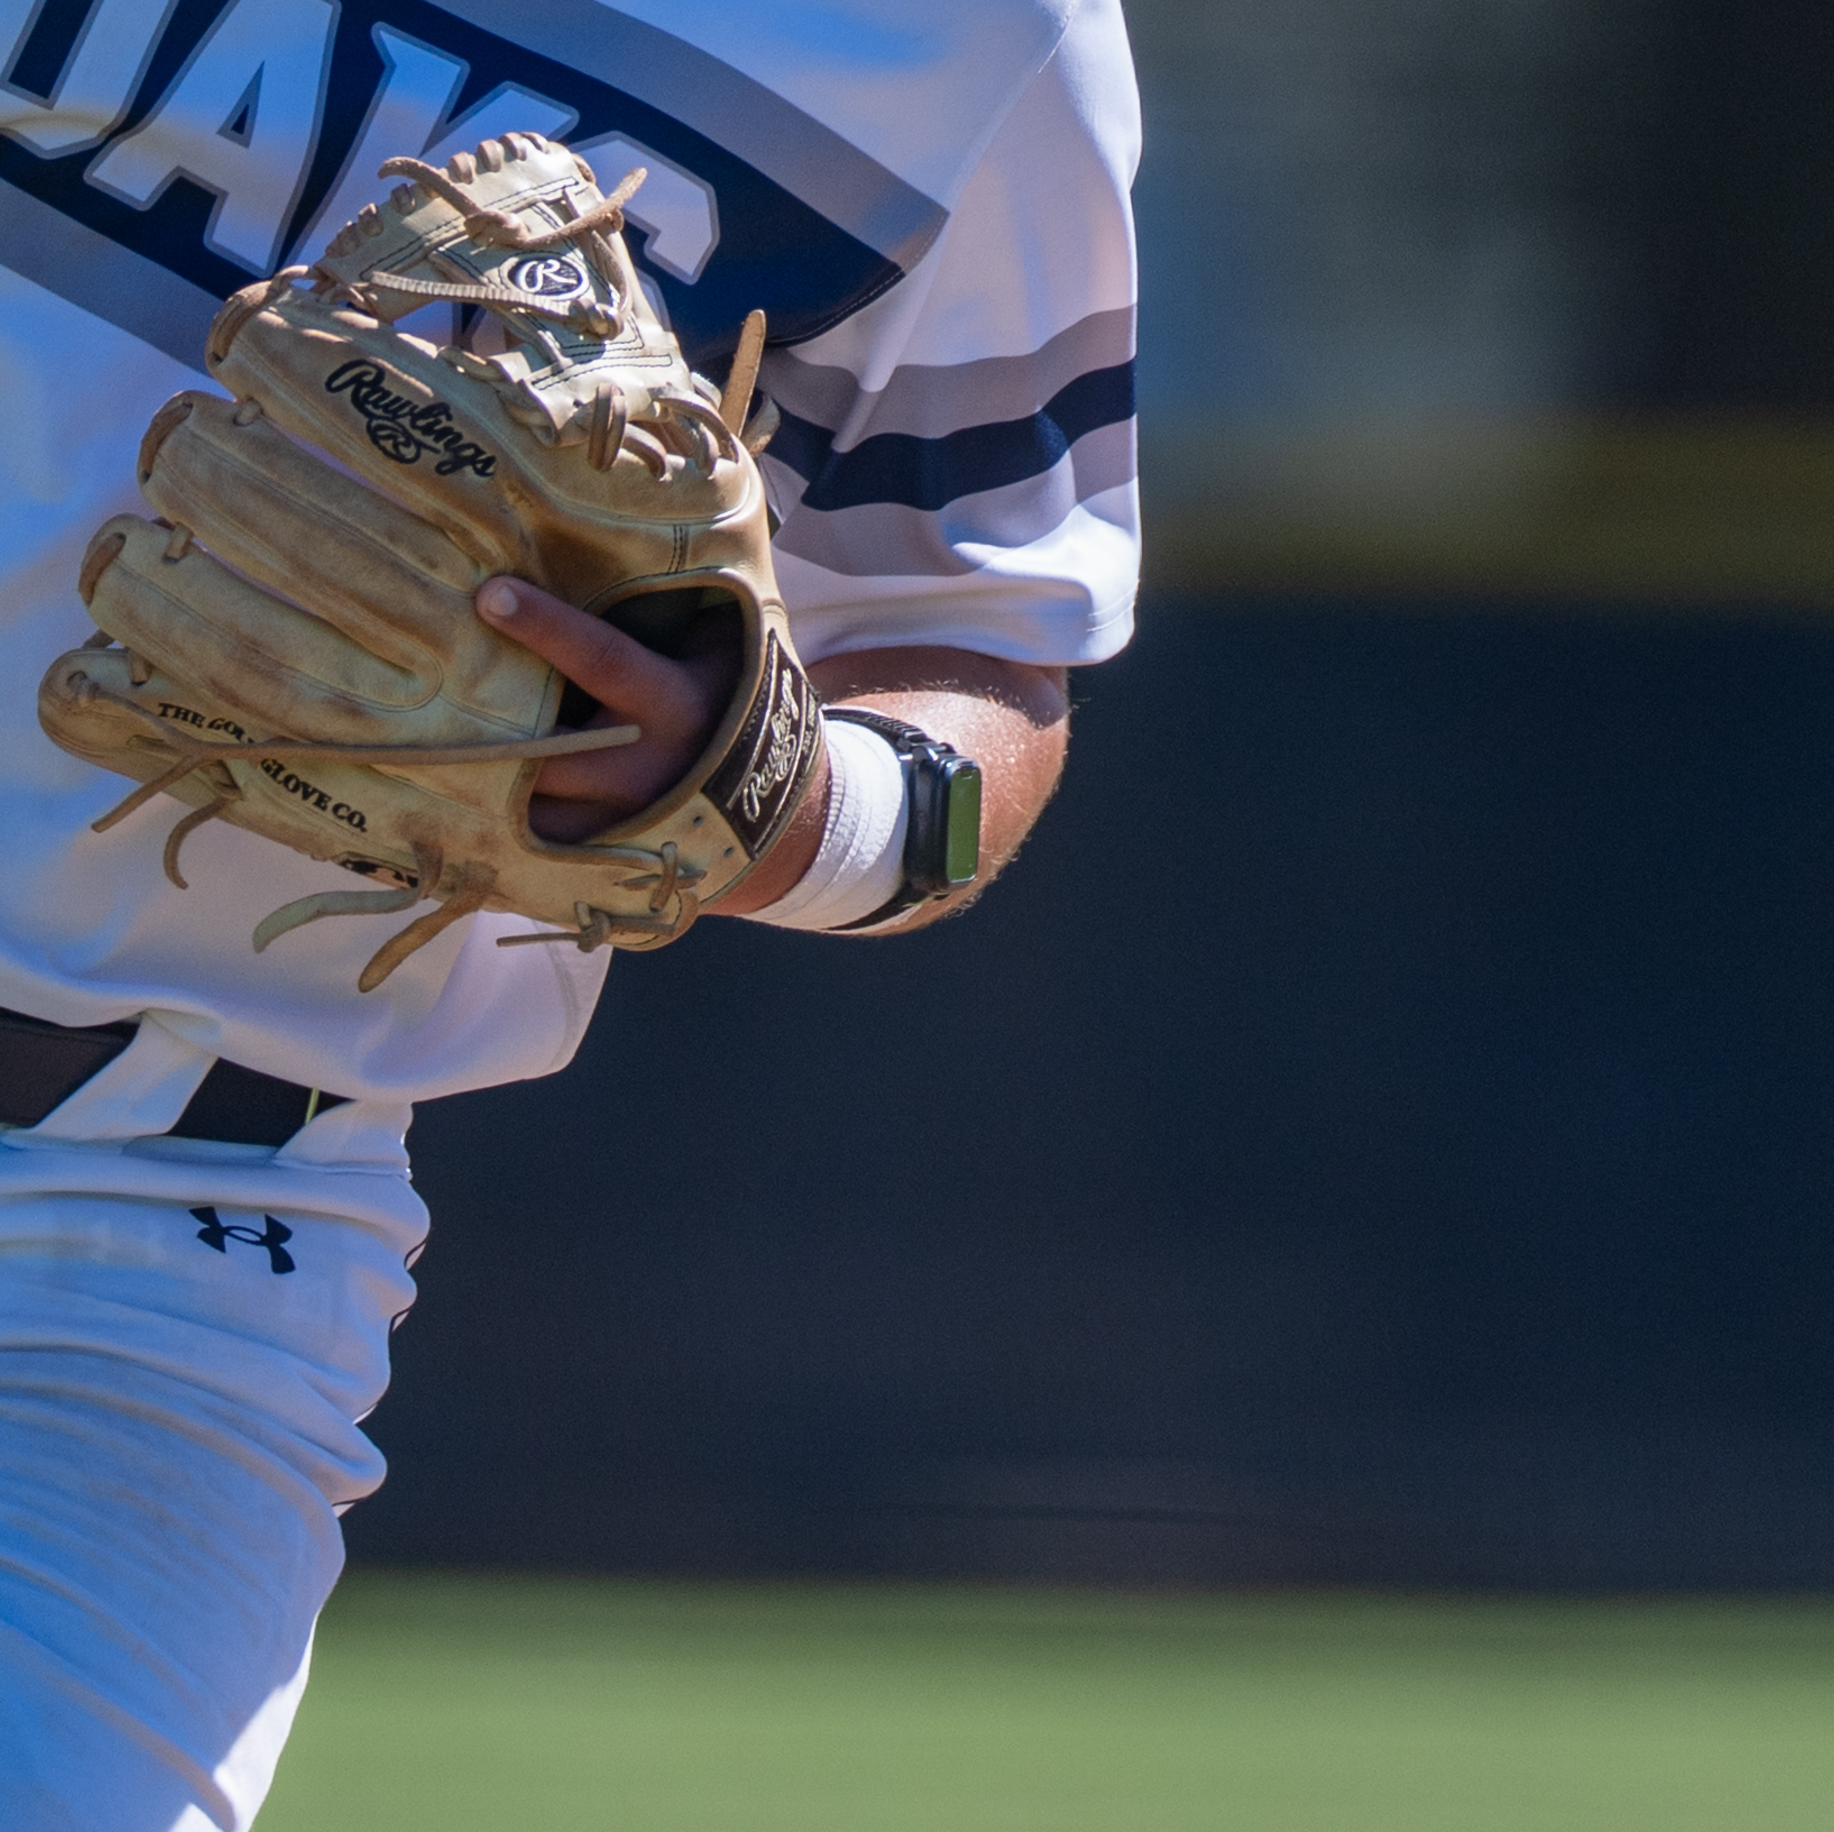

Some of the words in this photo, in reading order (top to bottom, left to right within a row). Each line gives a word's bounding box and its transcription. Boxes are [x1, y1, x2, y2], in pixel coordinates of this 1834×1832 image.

[325, 358, 497, 477] Rawlings
[157, 702, 206, 728] THE
[260, 758, 332, 811] GLOVE
[332, 802, 368, 833] CO.
[743, 668, 799, 823] Rawlings
